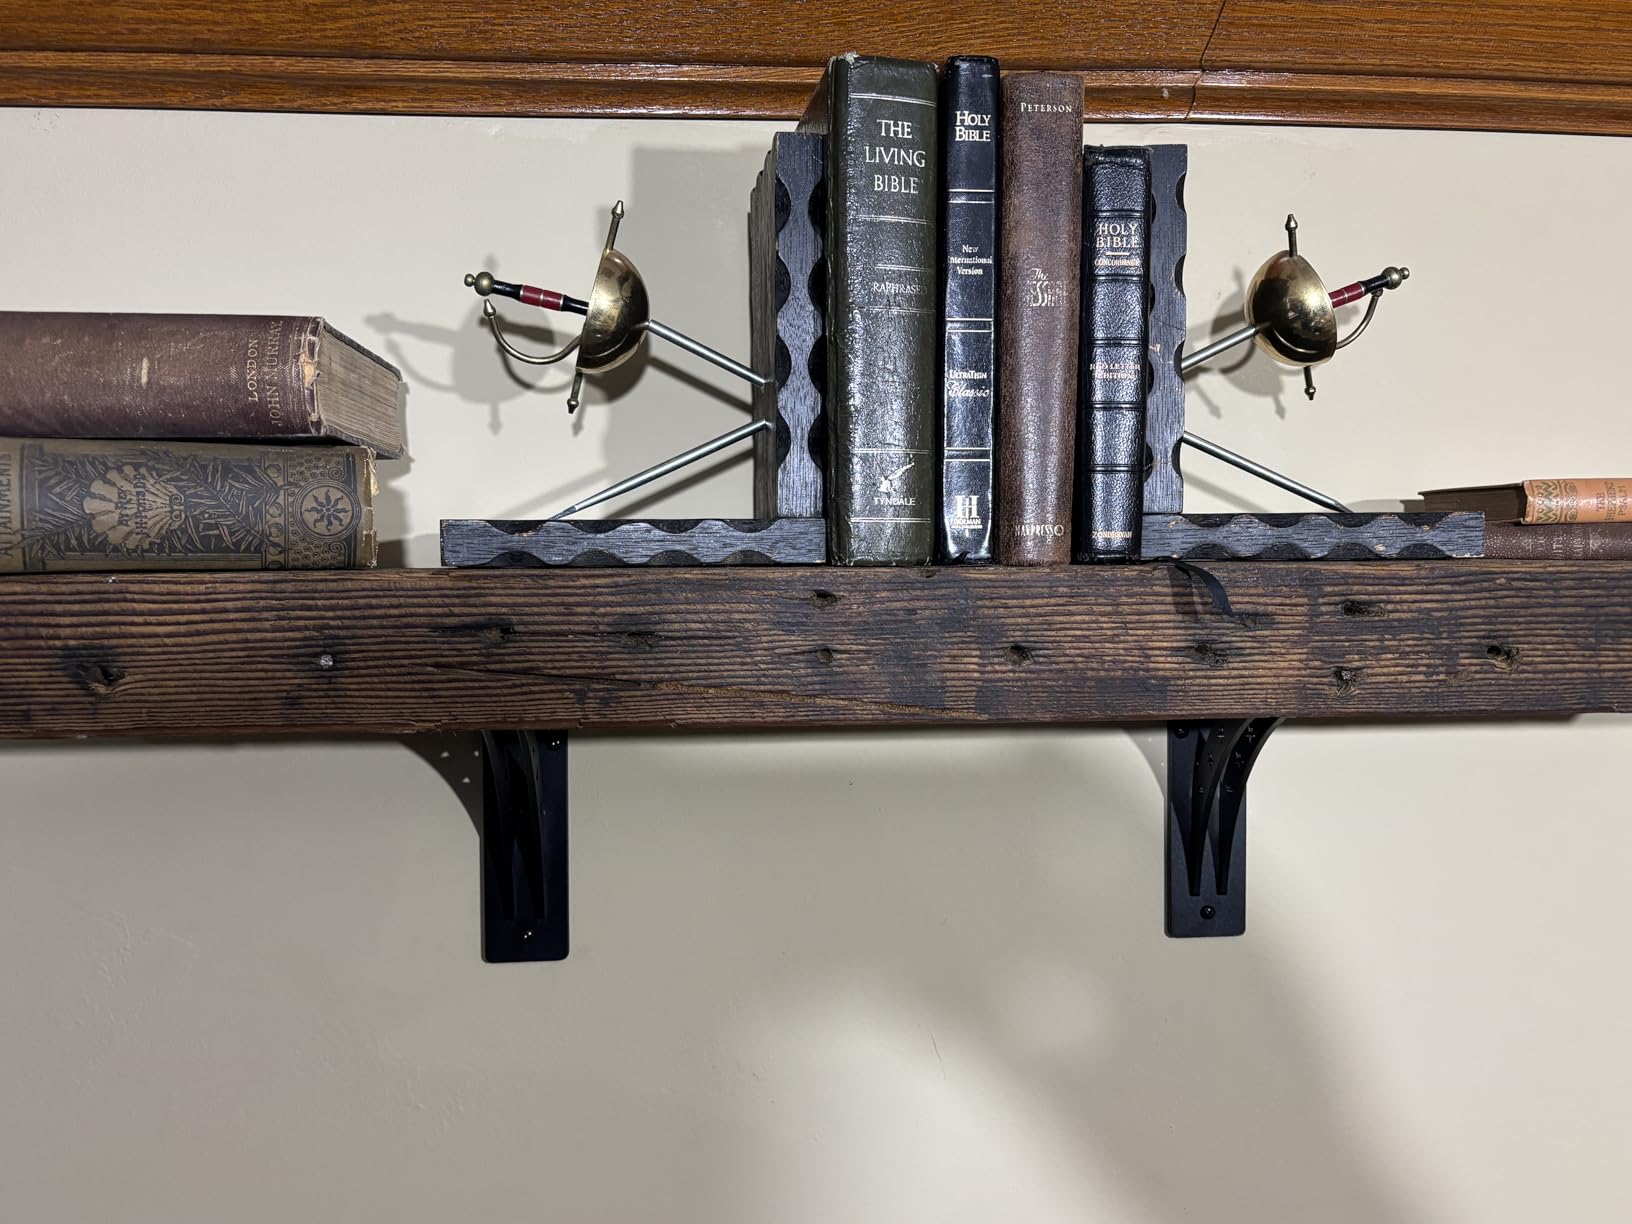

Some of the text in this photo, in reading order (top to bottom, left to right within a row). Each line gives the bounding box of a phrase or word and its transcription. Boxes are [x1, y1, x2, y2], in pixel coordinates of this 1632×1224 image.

[1020, 102, 1073, 113] PETERSON
[955, 111, 991, 127] HOLY
[876, 118, 913, 139] THE
[955, 126, 991, 143] BIBLE
[865, 145, 926, 168] LIVING
[874, 175, 920, 194] BIBLE
[1097, 222, 1137, 235] HOLY
[962, 244, 979, 253] New
[1096, 236, 1140, 248] BIBLE
[956, 266, 983, 275] Version
[1028, 267, 1049, 280] The
[246, 338, 260, 402] LONDON
[265, 320, 284, 427] JOHN MURRAY
[946, 380, 990, 398] Classic
[873, 496, 916, 506] TYNDALE
[1596, 492, 1605, 512] THE
[1616, 485, 1628, 516] PSALM
